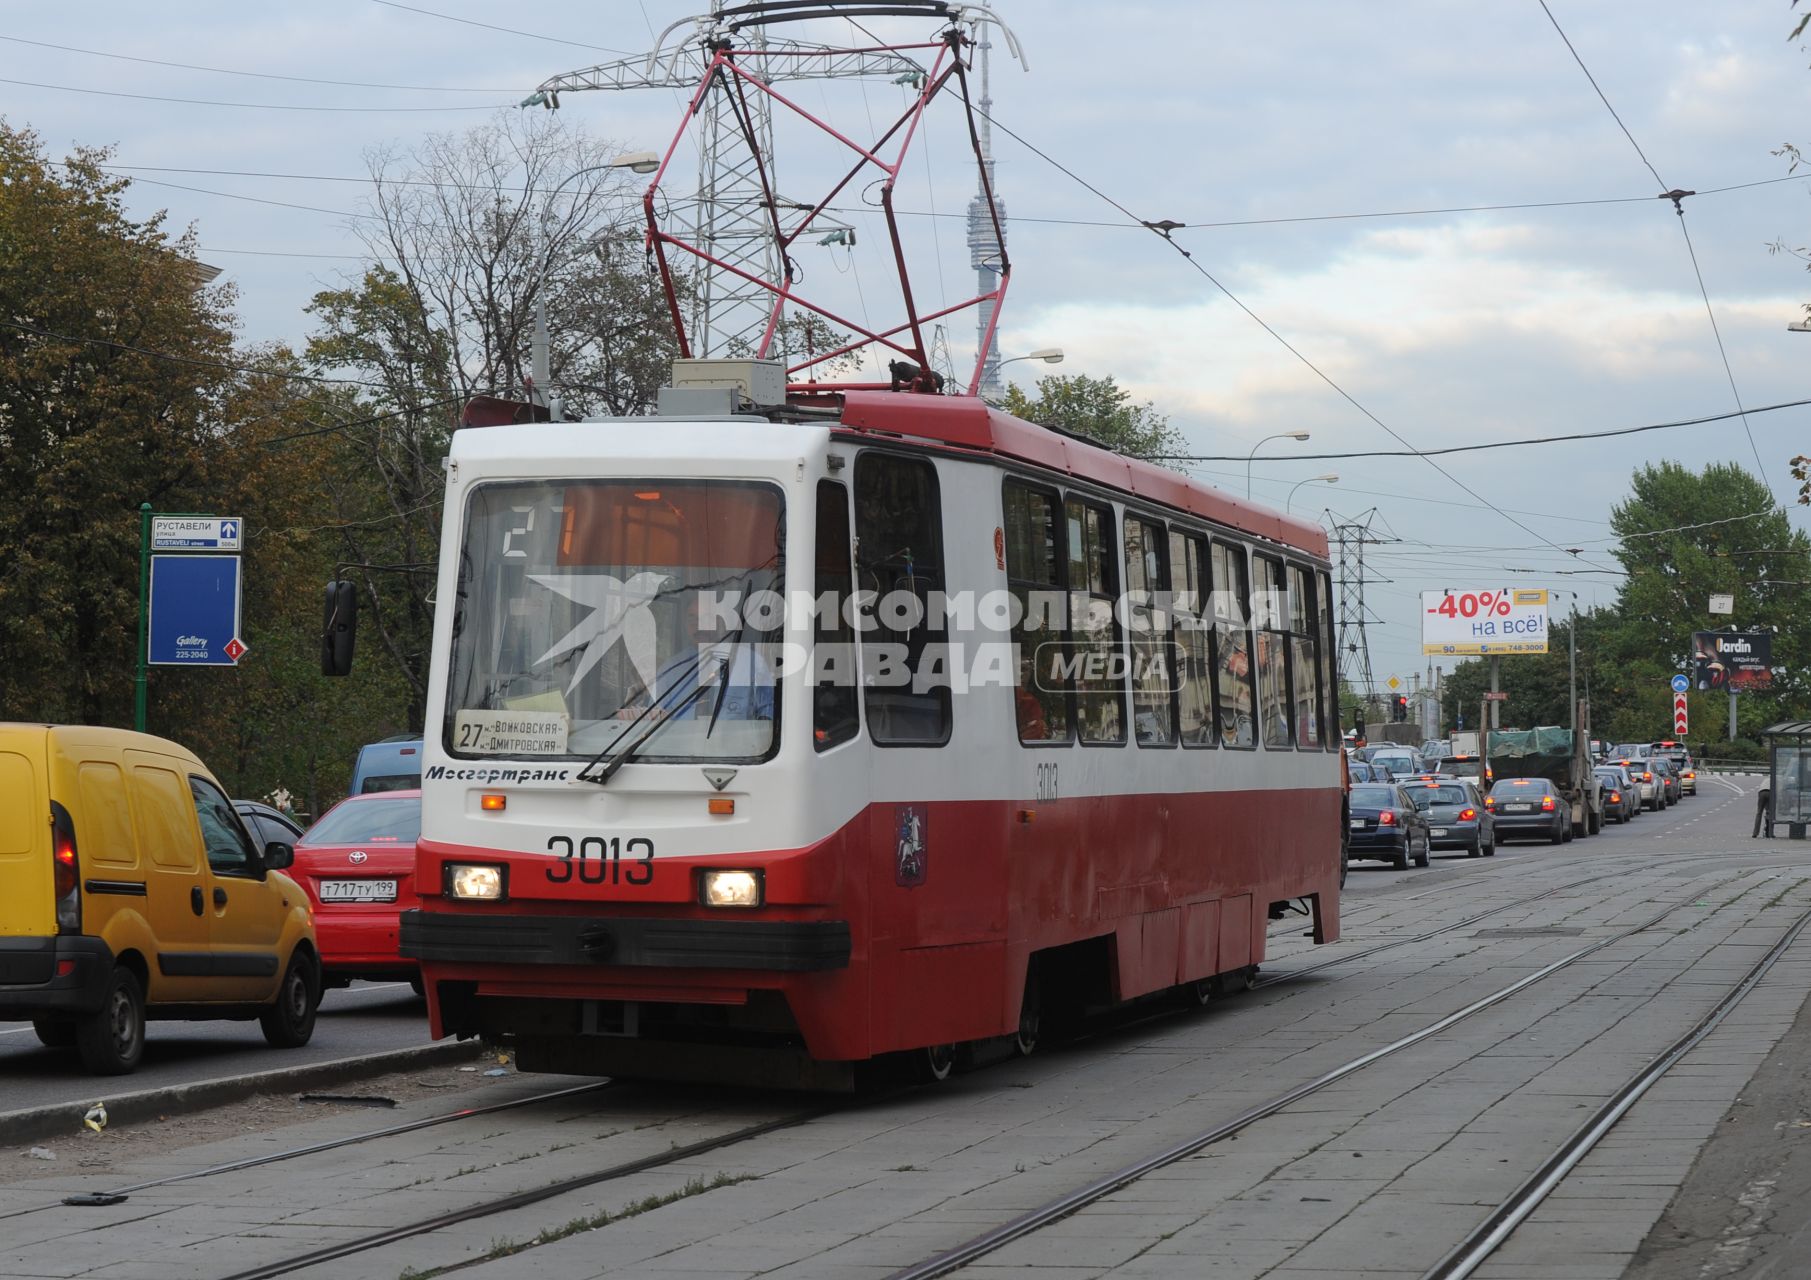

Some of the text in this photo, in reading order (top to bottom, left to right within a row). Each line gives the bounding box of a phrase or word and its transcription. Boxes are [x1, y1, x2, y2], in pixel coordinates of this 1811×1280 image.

[156, 522, 212, 530] РУСТАВЕЛИ
[502, 505, 575, 557] 27
[1427, 590, 1511, 618] -40%
[1472, 614, 1544, 635] на всё!
[176, 635, 208, 648] Gallery
[1443, 645, 1456, 653] 90
[1716, 637, 1752, 653] Jardin
[175, 651, 209, 659] 225-2040
[460, 723, 483, 747] 27
[424, 765, 570, 785] Мосгортранс
[1036, 762, 1058, 804] 3013
[545, 835, 655, 886] 3013
[375, 881, 393, 892] 199
